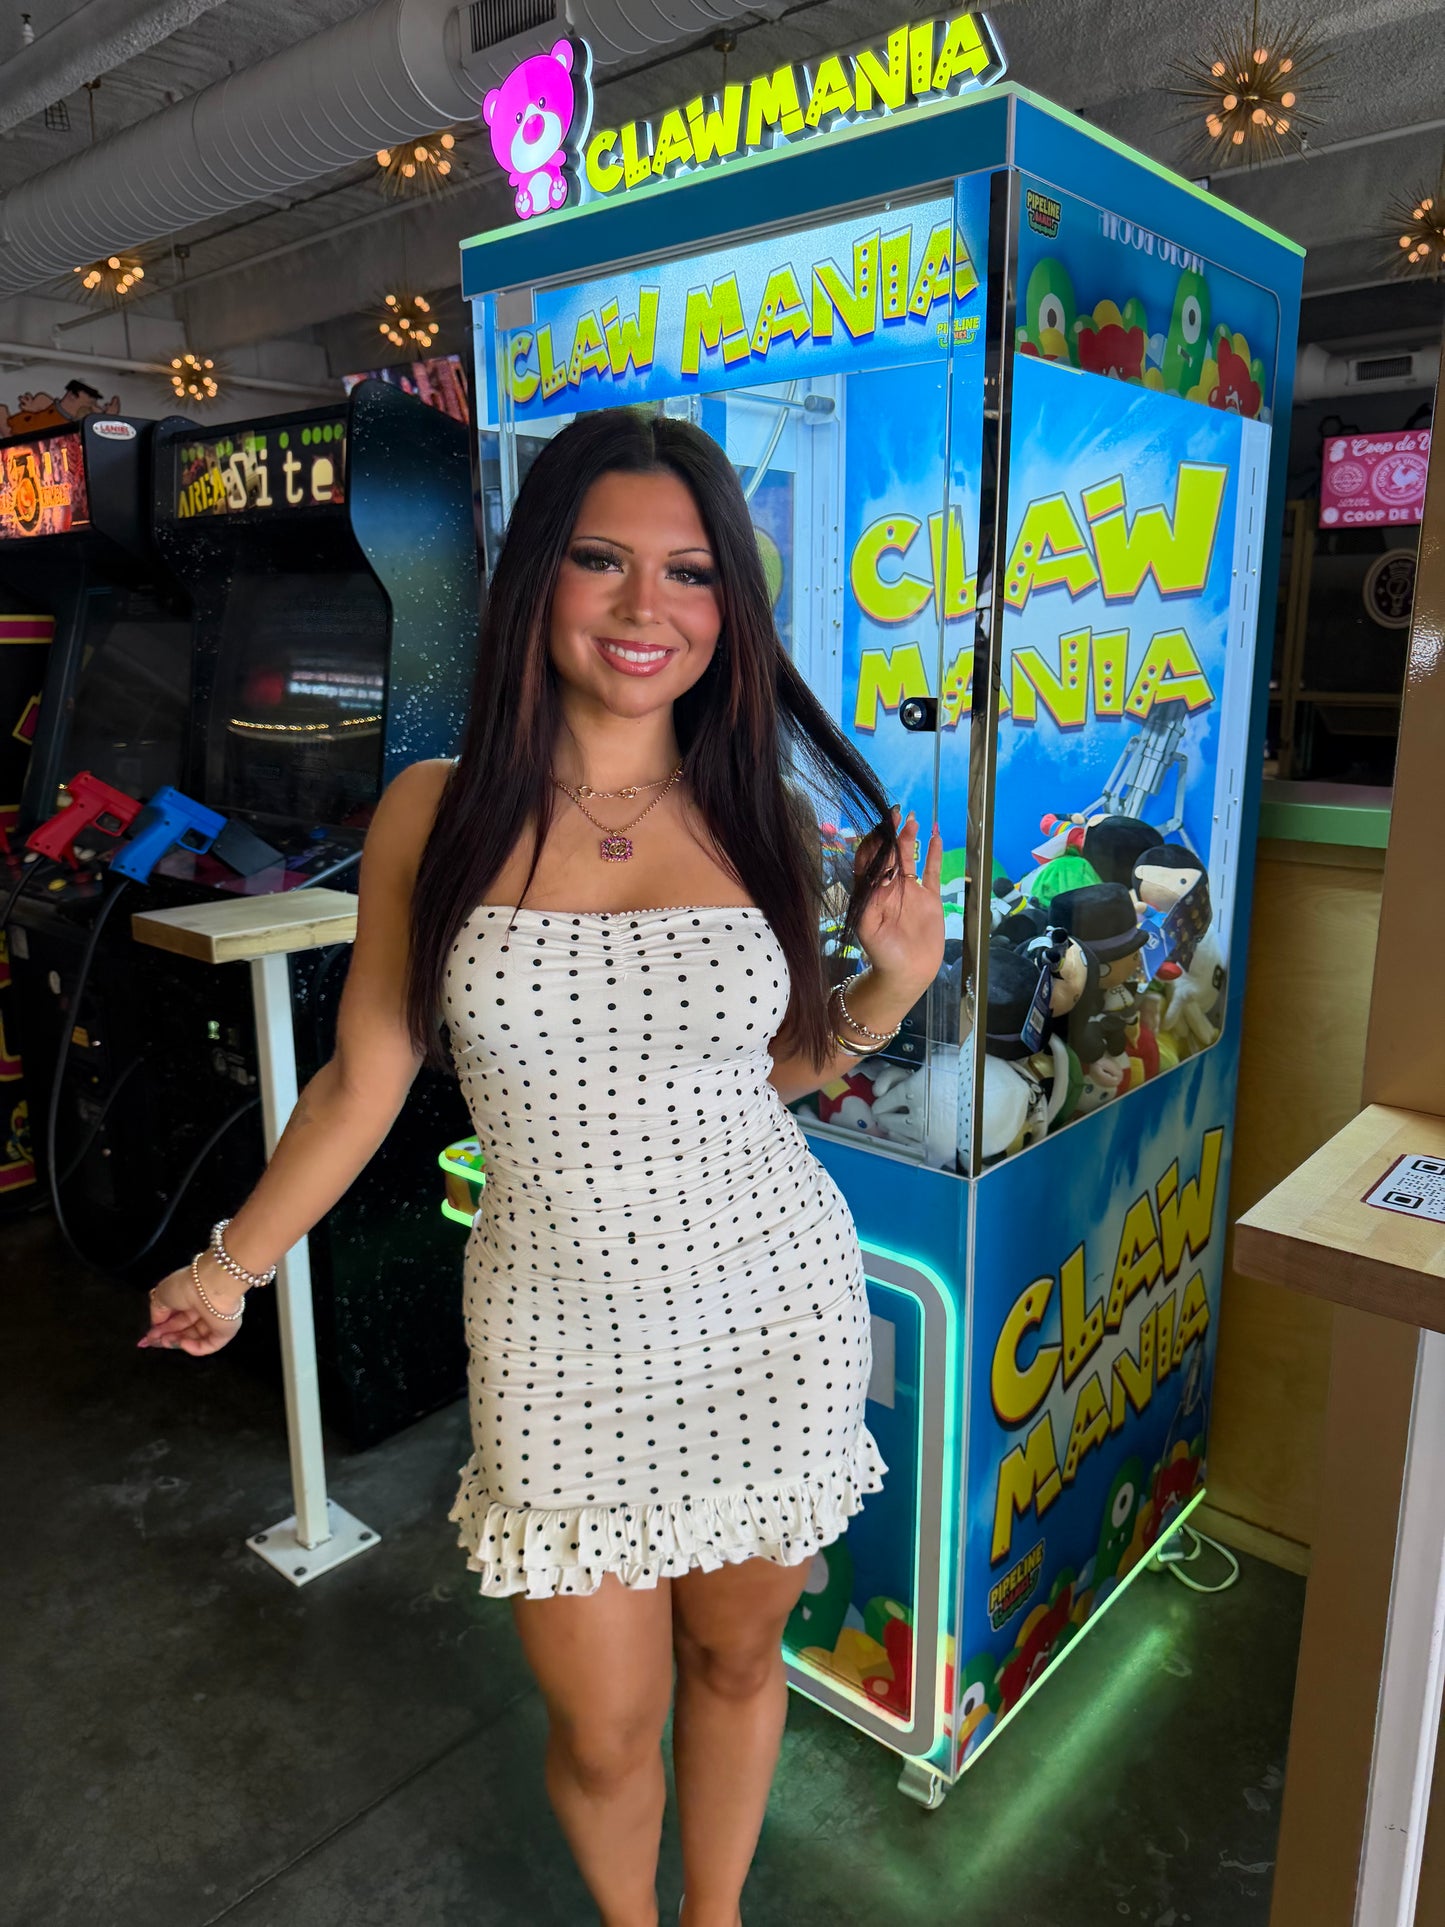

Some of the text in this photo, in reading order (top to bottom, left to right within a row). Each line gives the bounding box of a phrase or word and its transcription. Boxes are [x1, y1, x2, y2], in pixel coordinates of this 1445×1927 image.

[1027, 191, 1060, 221] PIPELINE
[507, 219, 979, 403] CLAW MANIA
[178, 466, 226, 519] AREA
[1343, 509, 1386, 522] COOP
[1388, 508, 1410, 521] DE
[990, 1127, 1225, 1429] CLAW
[989, 1269, 1210, 1566] MANIA
[989, 1543, 1044, 1614] PIPELINE
